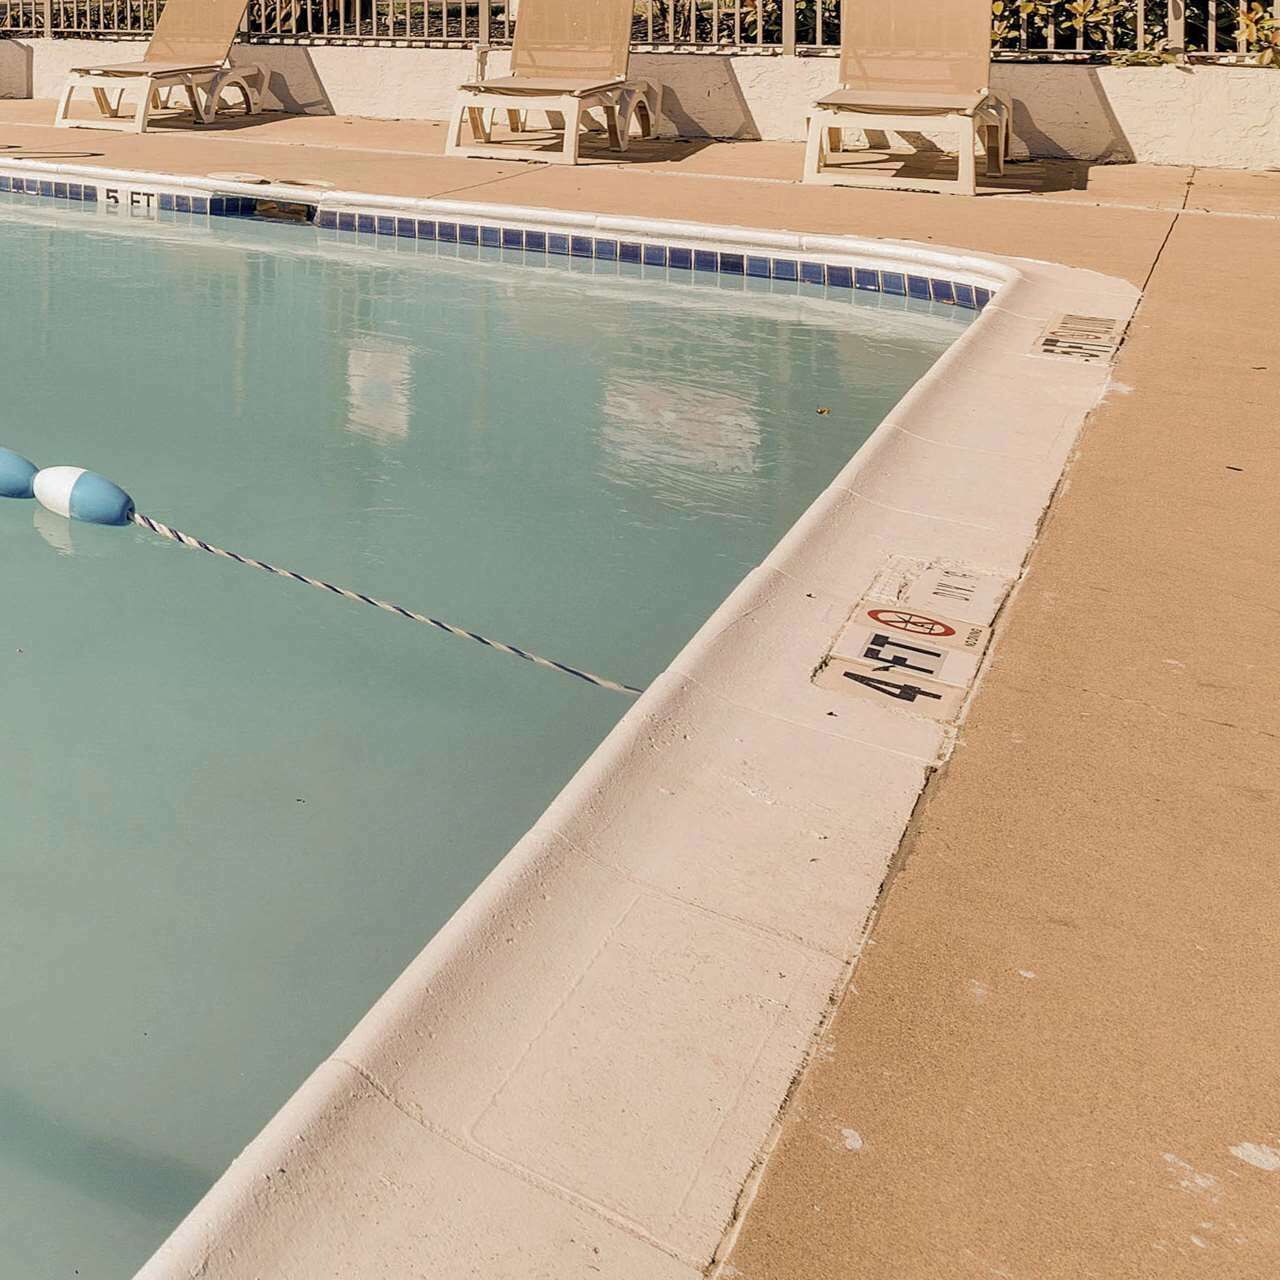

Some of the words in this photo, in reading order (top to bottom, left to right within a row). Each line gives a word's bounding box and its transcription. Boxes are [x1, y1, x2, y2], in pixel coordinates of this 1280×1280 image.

[106, 188, 119, 204] 5
[130, 191, 155, 207] FT
[863, 633, 942, 675] FT
[843, 671, 942, 703] 4
